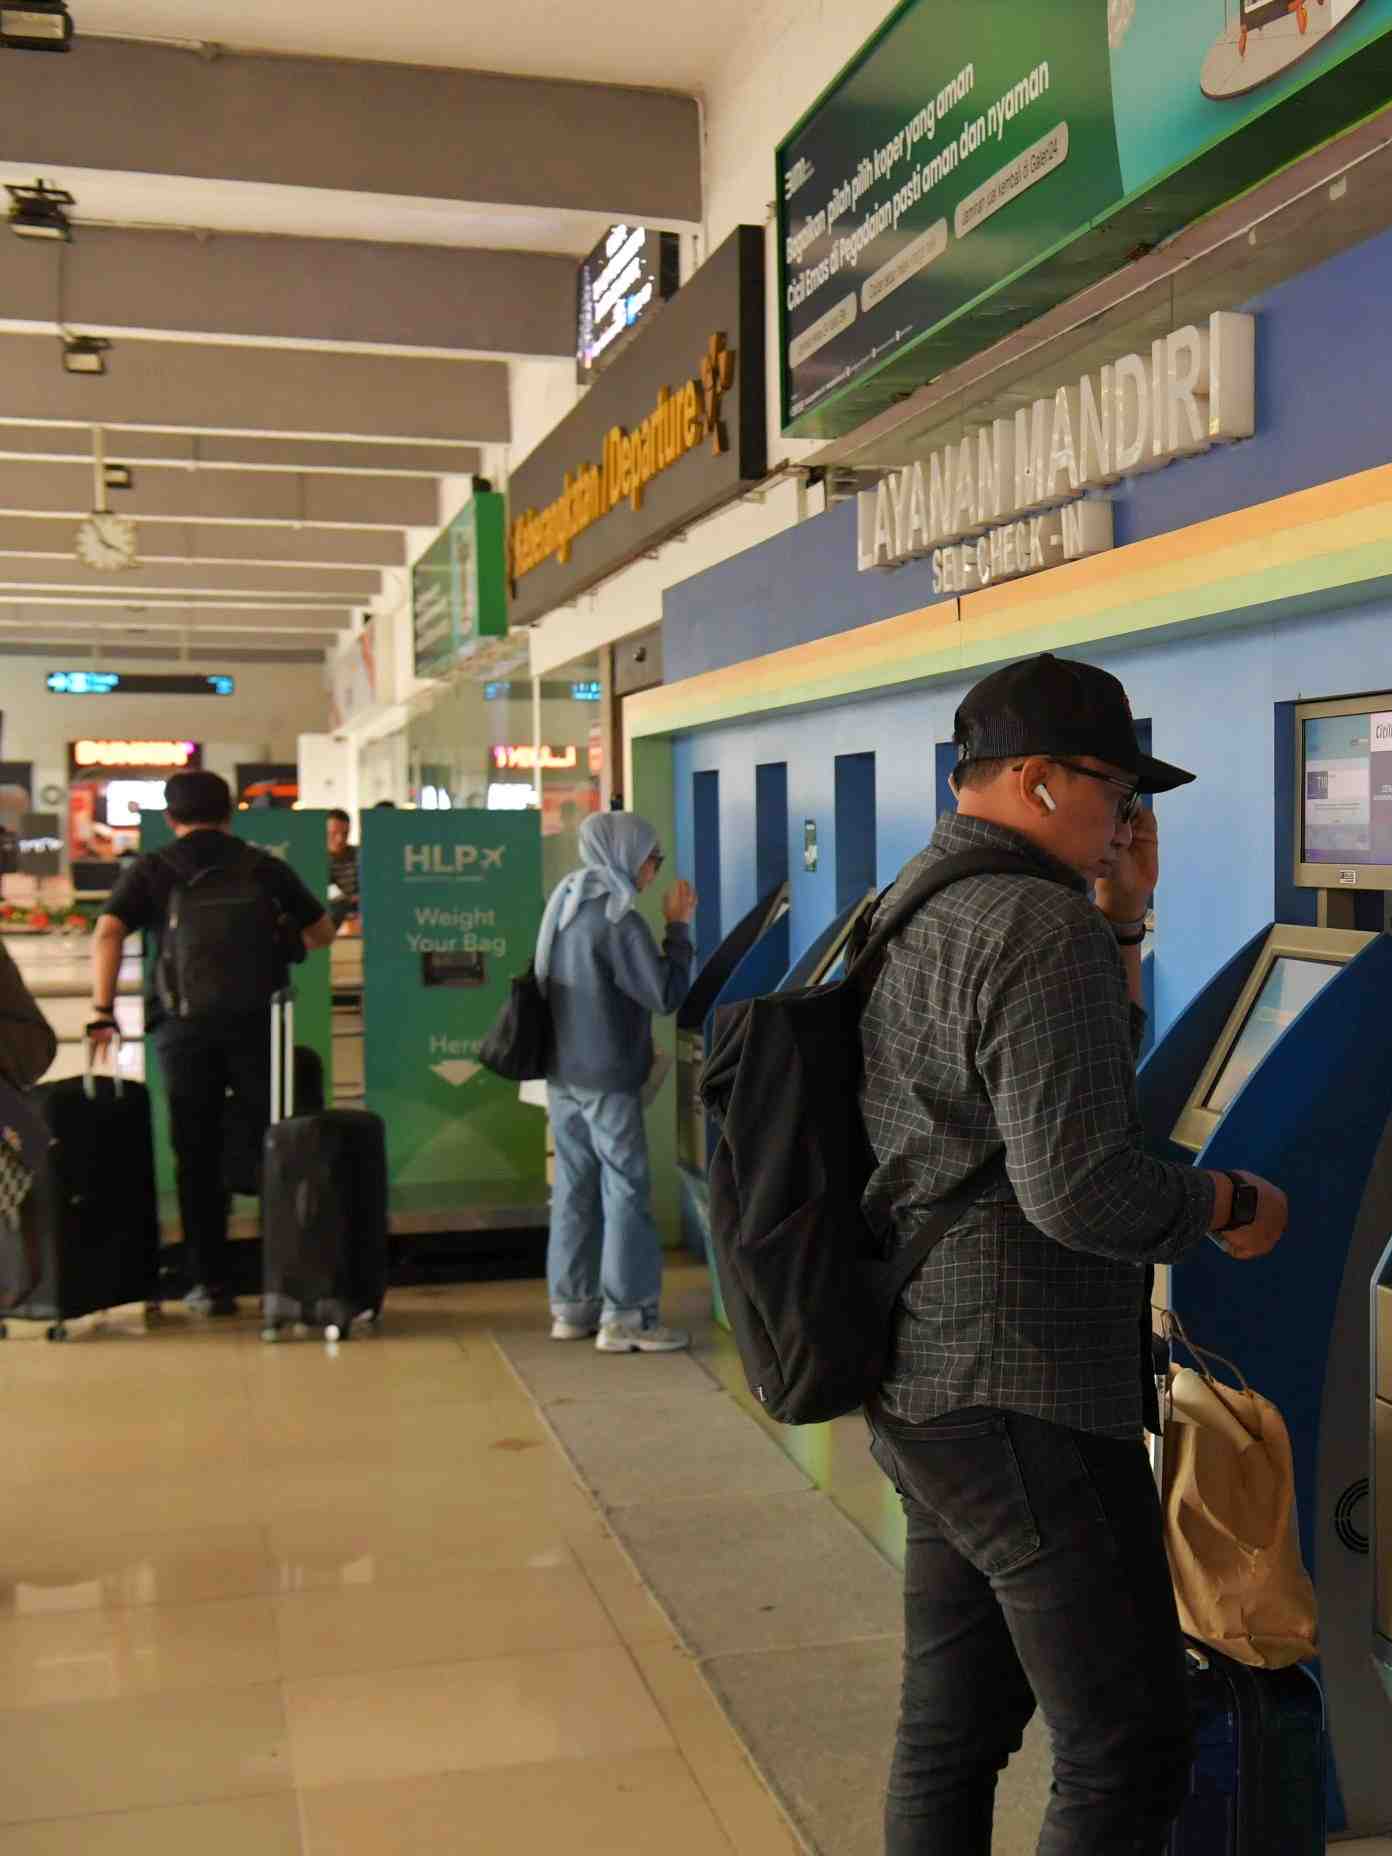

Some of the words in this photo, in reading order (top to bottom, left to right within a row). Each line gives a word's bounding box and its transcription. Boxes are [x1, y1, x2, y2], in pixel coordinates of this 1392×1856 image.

[840, 201, 892, 267] Pegadaian
[892, 163, 921, 231] pasti
[922, 141, 959, 193] aman
[959, 120, 986, 160] dan
[986, 60, 1049, 141] nyaman
[873, 130, 904, 180] koper
[904, 99, 936, 161] yang
[936, 62, 974, 119] aman
[610, 379, 700, 514] Departure
[857, 417, 1013, 572] LAYANAN
[1014, 311, 1240, 511] MANDIRI
[403, 845, 479, 872] HLP
[406, 932, 459, 952] Your
[463, 932, 506, 957] Bag
[415, 906, 497, 931] Weight
